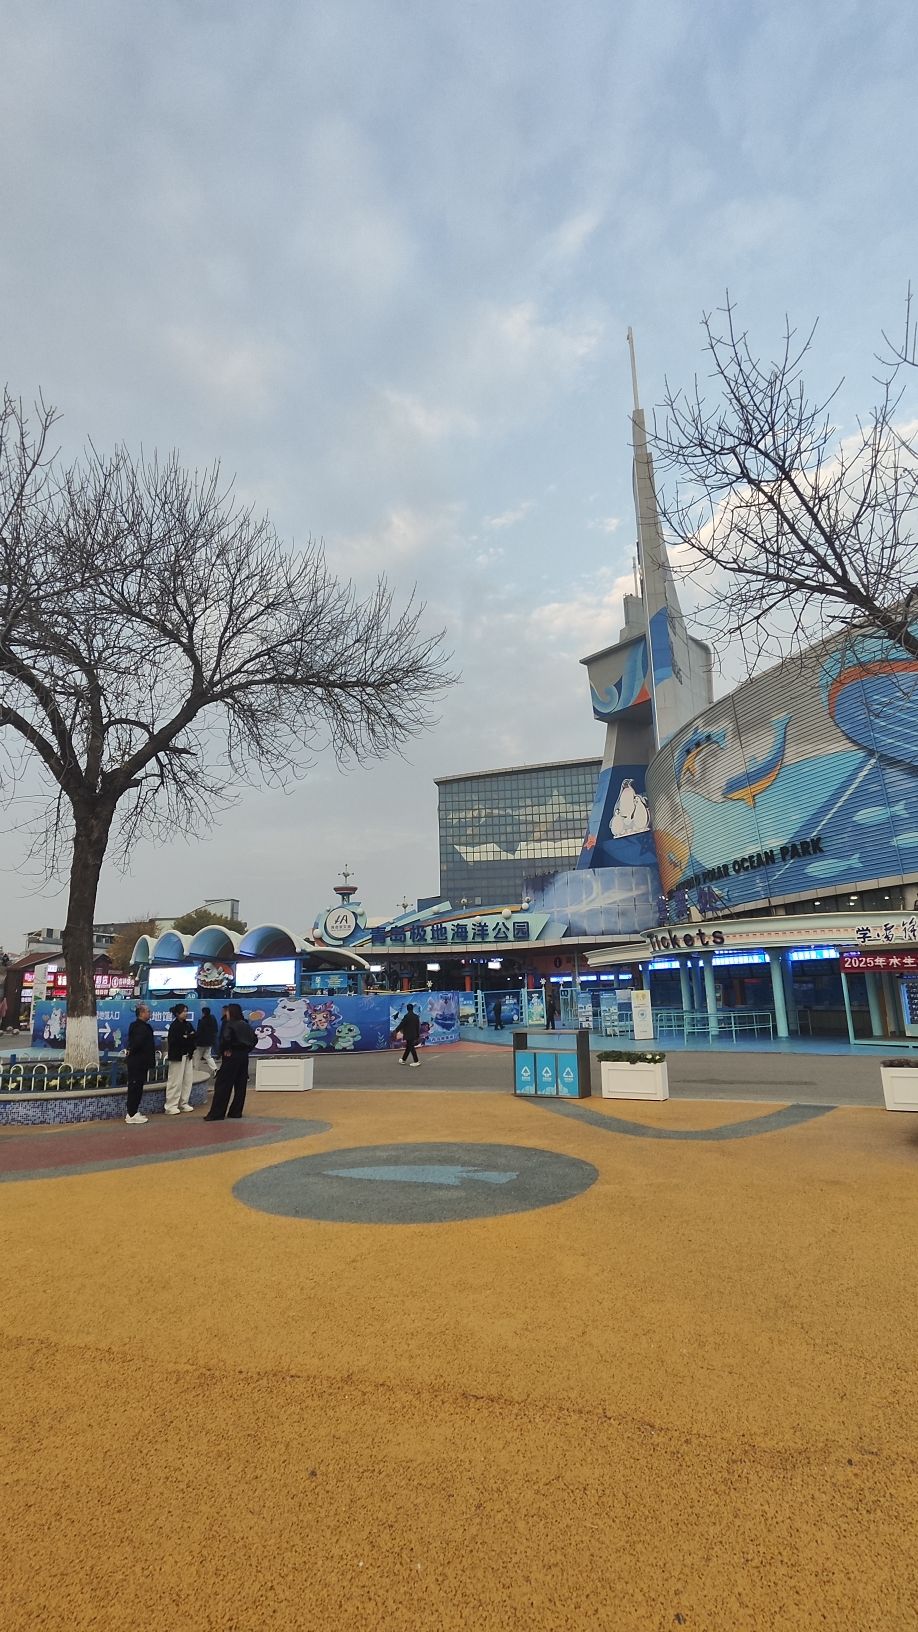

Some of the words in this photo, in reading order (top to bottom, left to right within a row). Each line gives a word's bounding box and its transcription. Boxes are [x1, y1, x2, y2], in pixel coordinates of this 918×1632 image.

[732, 849, 776, 877] OCEAN
[780, 836, 825, 861] PARK
[369, 921, 530, 945] 青岛极地海洋公园
[647, 927, 725, 951] Tickets
[844, 955, 917, 968] 2025年水生
